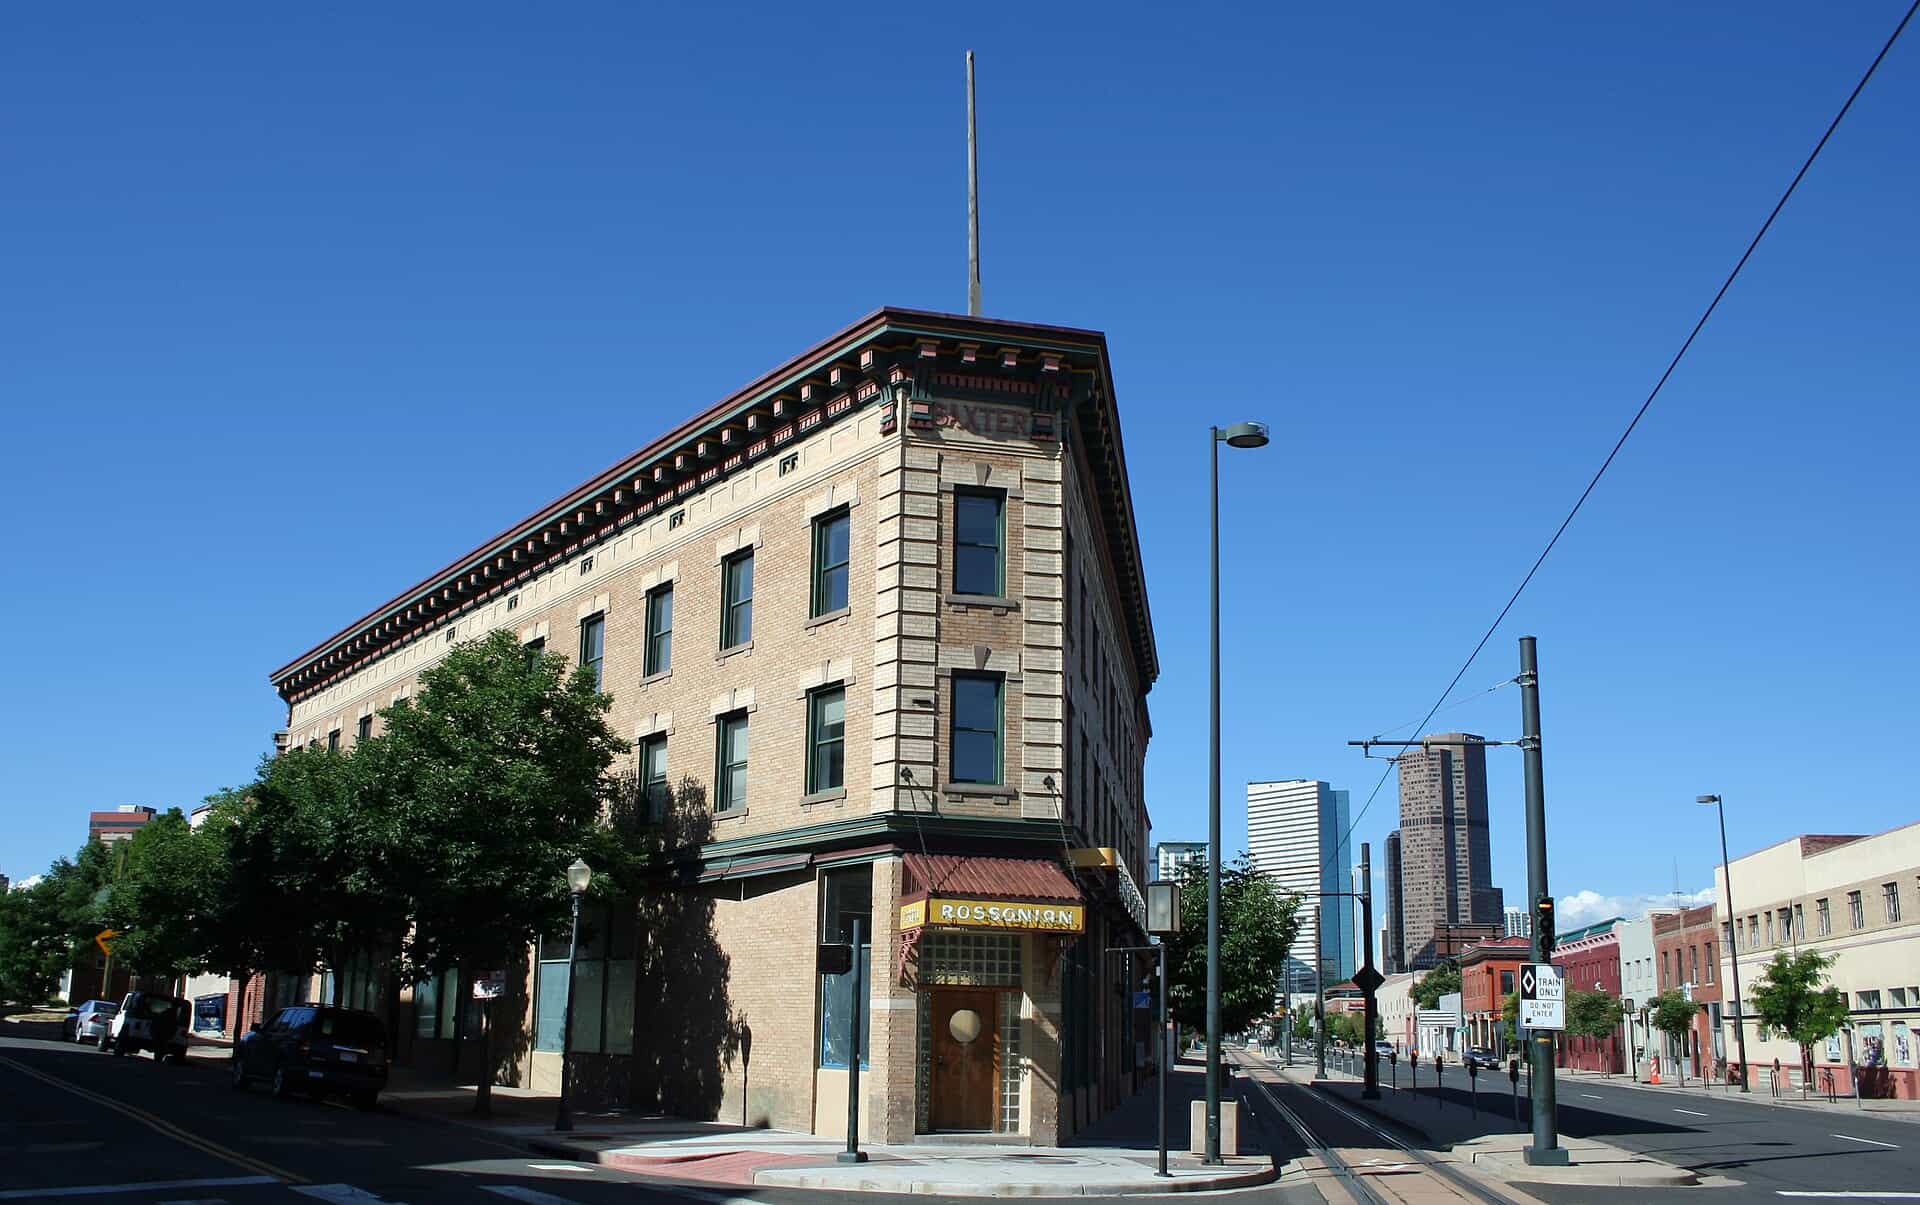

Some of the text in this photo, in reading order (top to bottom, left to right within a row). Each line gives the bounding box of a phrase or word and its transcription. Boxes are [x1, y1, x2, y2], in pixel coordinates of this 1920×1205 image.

[935, 402, 1026, 434] BAXTER
[942, 904, 1073, 925] ROSSONIAN
[1538, 978, 1560, 987] TRAIN
[1539, 988, 1559, 996] ONLY
